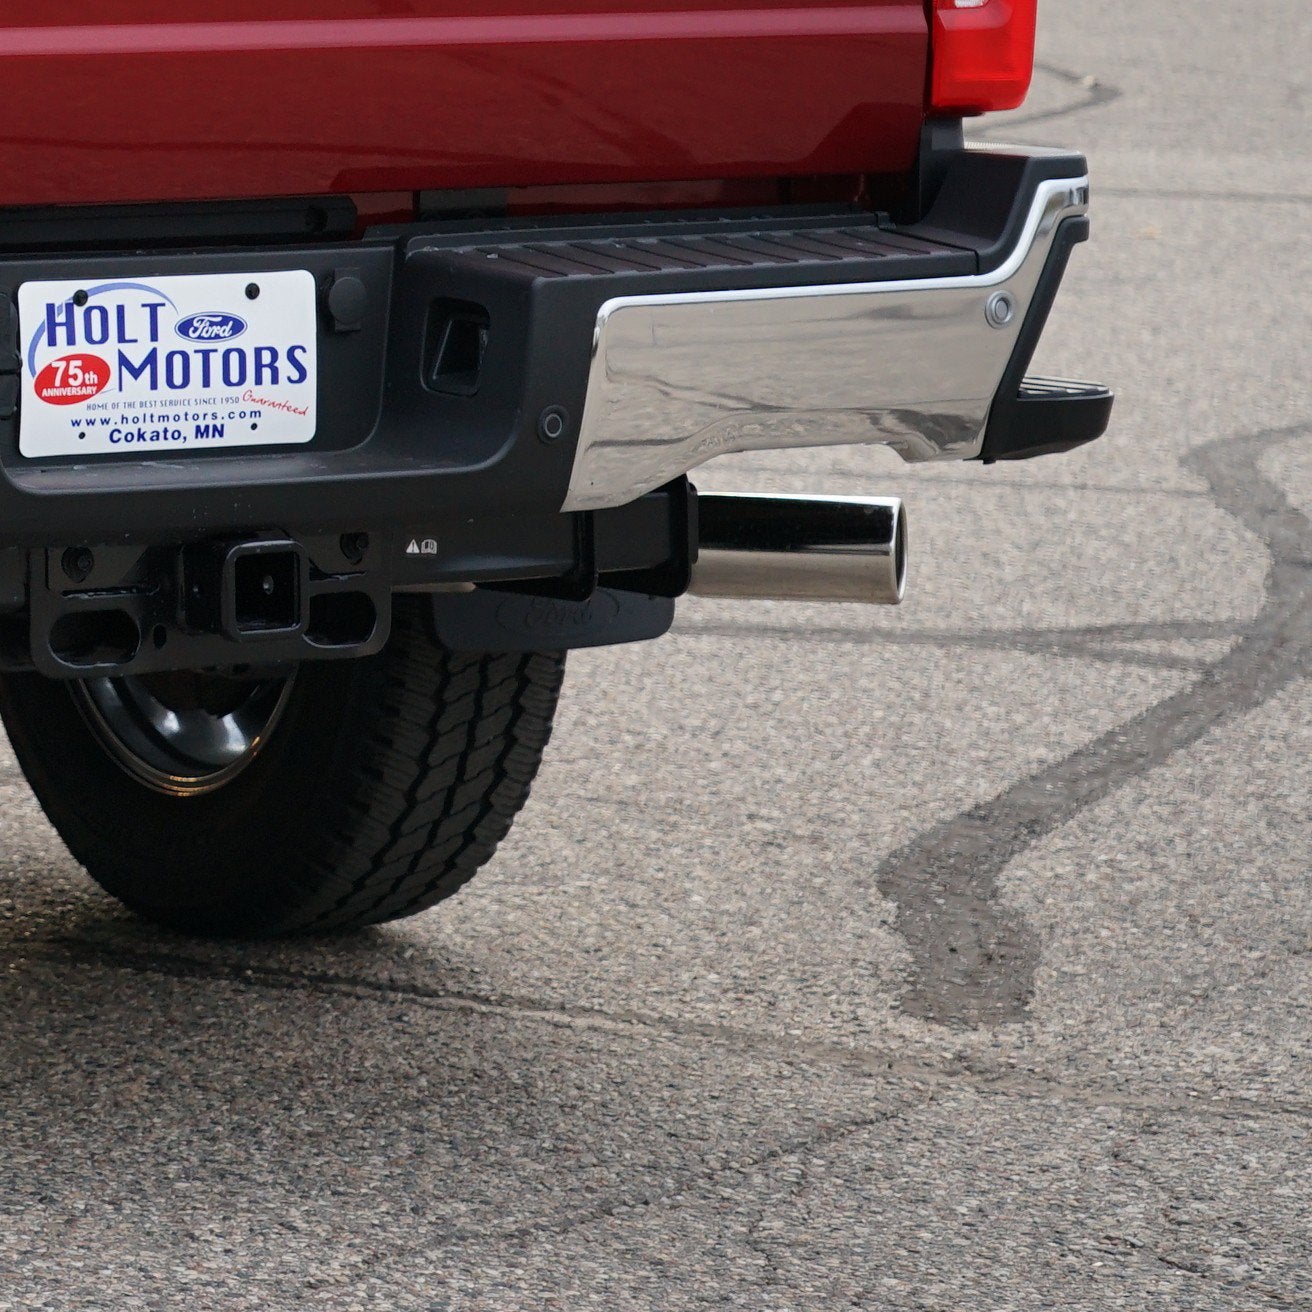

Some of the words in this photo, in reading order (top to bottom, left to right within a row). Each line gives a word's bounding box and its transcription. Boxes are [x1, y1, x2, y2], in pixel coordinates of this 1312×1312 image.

[46, 303, 166, 347] HOLT
[188, 316, 234, 338] Ford
[51, 360, 99, 387] 75th
[118, 345, 307, 392] MOTORS
[42, 386, 97, 397] ANNIVERSARY
[242, 389, 308, 416] Guaranteed
[86, 403, 109, 411] HOME
[111, 402, 120, 410] OF
[123, 401, 136, 409] THE
[139, 400, 158, 408] BEST
[160, 399, 191, 408] SERVICE
[194, 397, 217, 406] SINCE
[220, 396, 240, 405] 1950
[70, 409, 262, 427] www.holtmotors.com
[109, 427, 187, 444] Cokato,
[194, 424, 225, 439] MN
